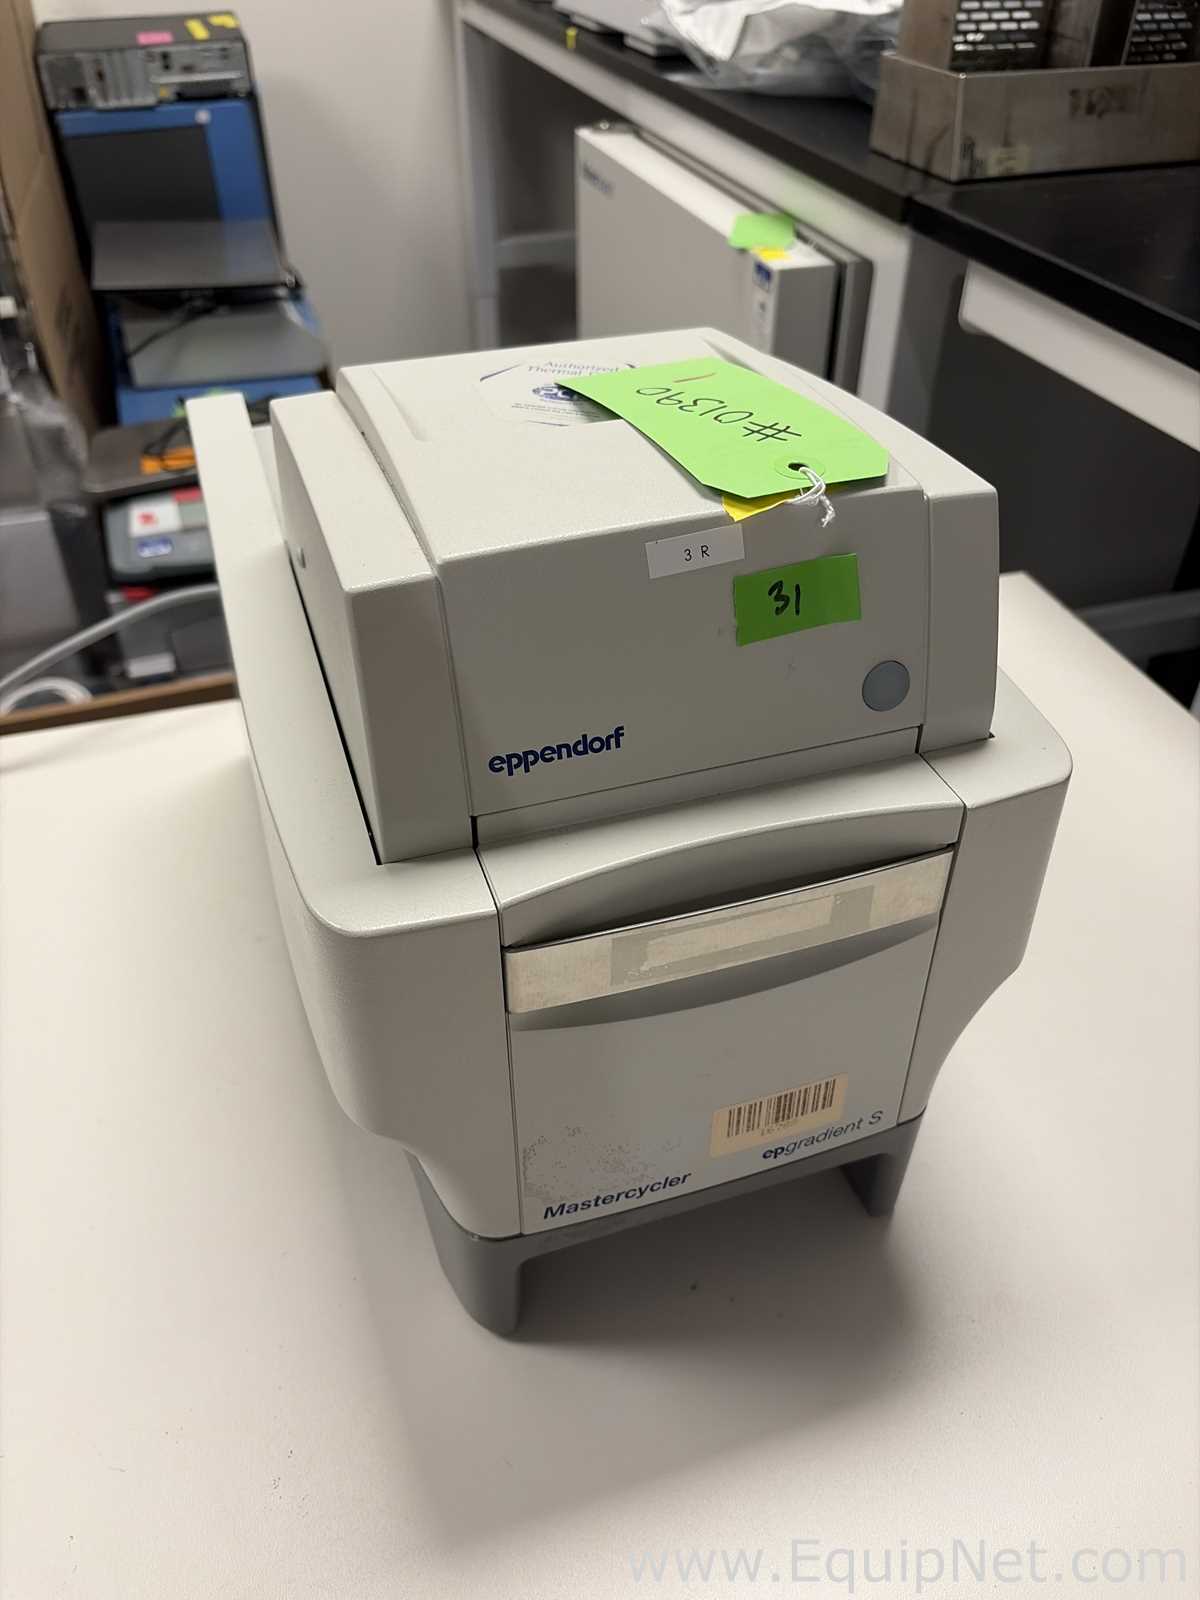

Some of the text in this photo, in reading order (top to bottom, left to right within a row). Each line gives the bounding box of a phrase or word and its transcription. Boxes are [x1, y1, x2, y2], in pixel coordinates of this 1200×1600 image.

[684, 544, 711, 562] 3 R
[767, 580, 801, 616] 31
[488, 725, 625, 777] eppendorf
[762, 1116, 864, 1160] epgradient
[868, 1110, 884, 1126] S
[542, 1171, 692, 1220] Mastercycler
